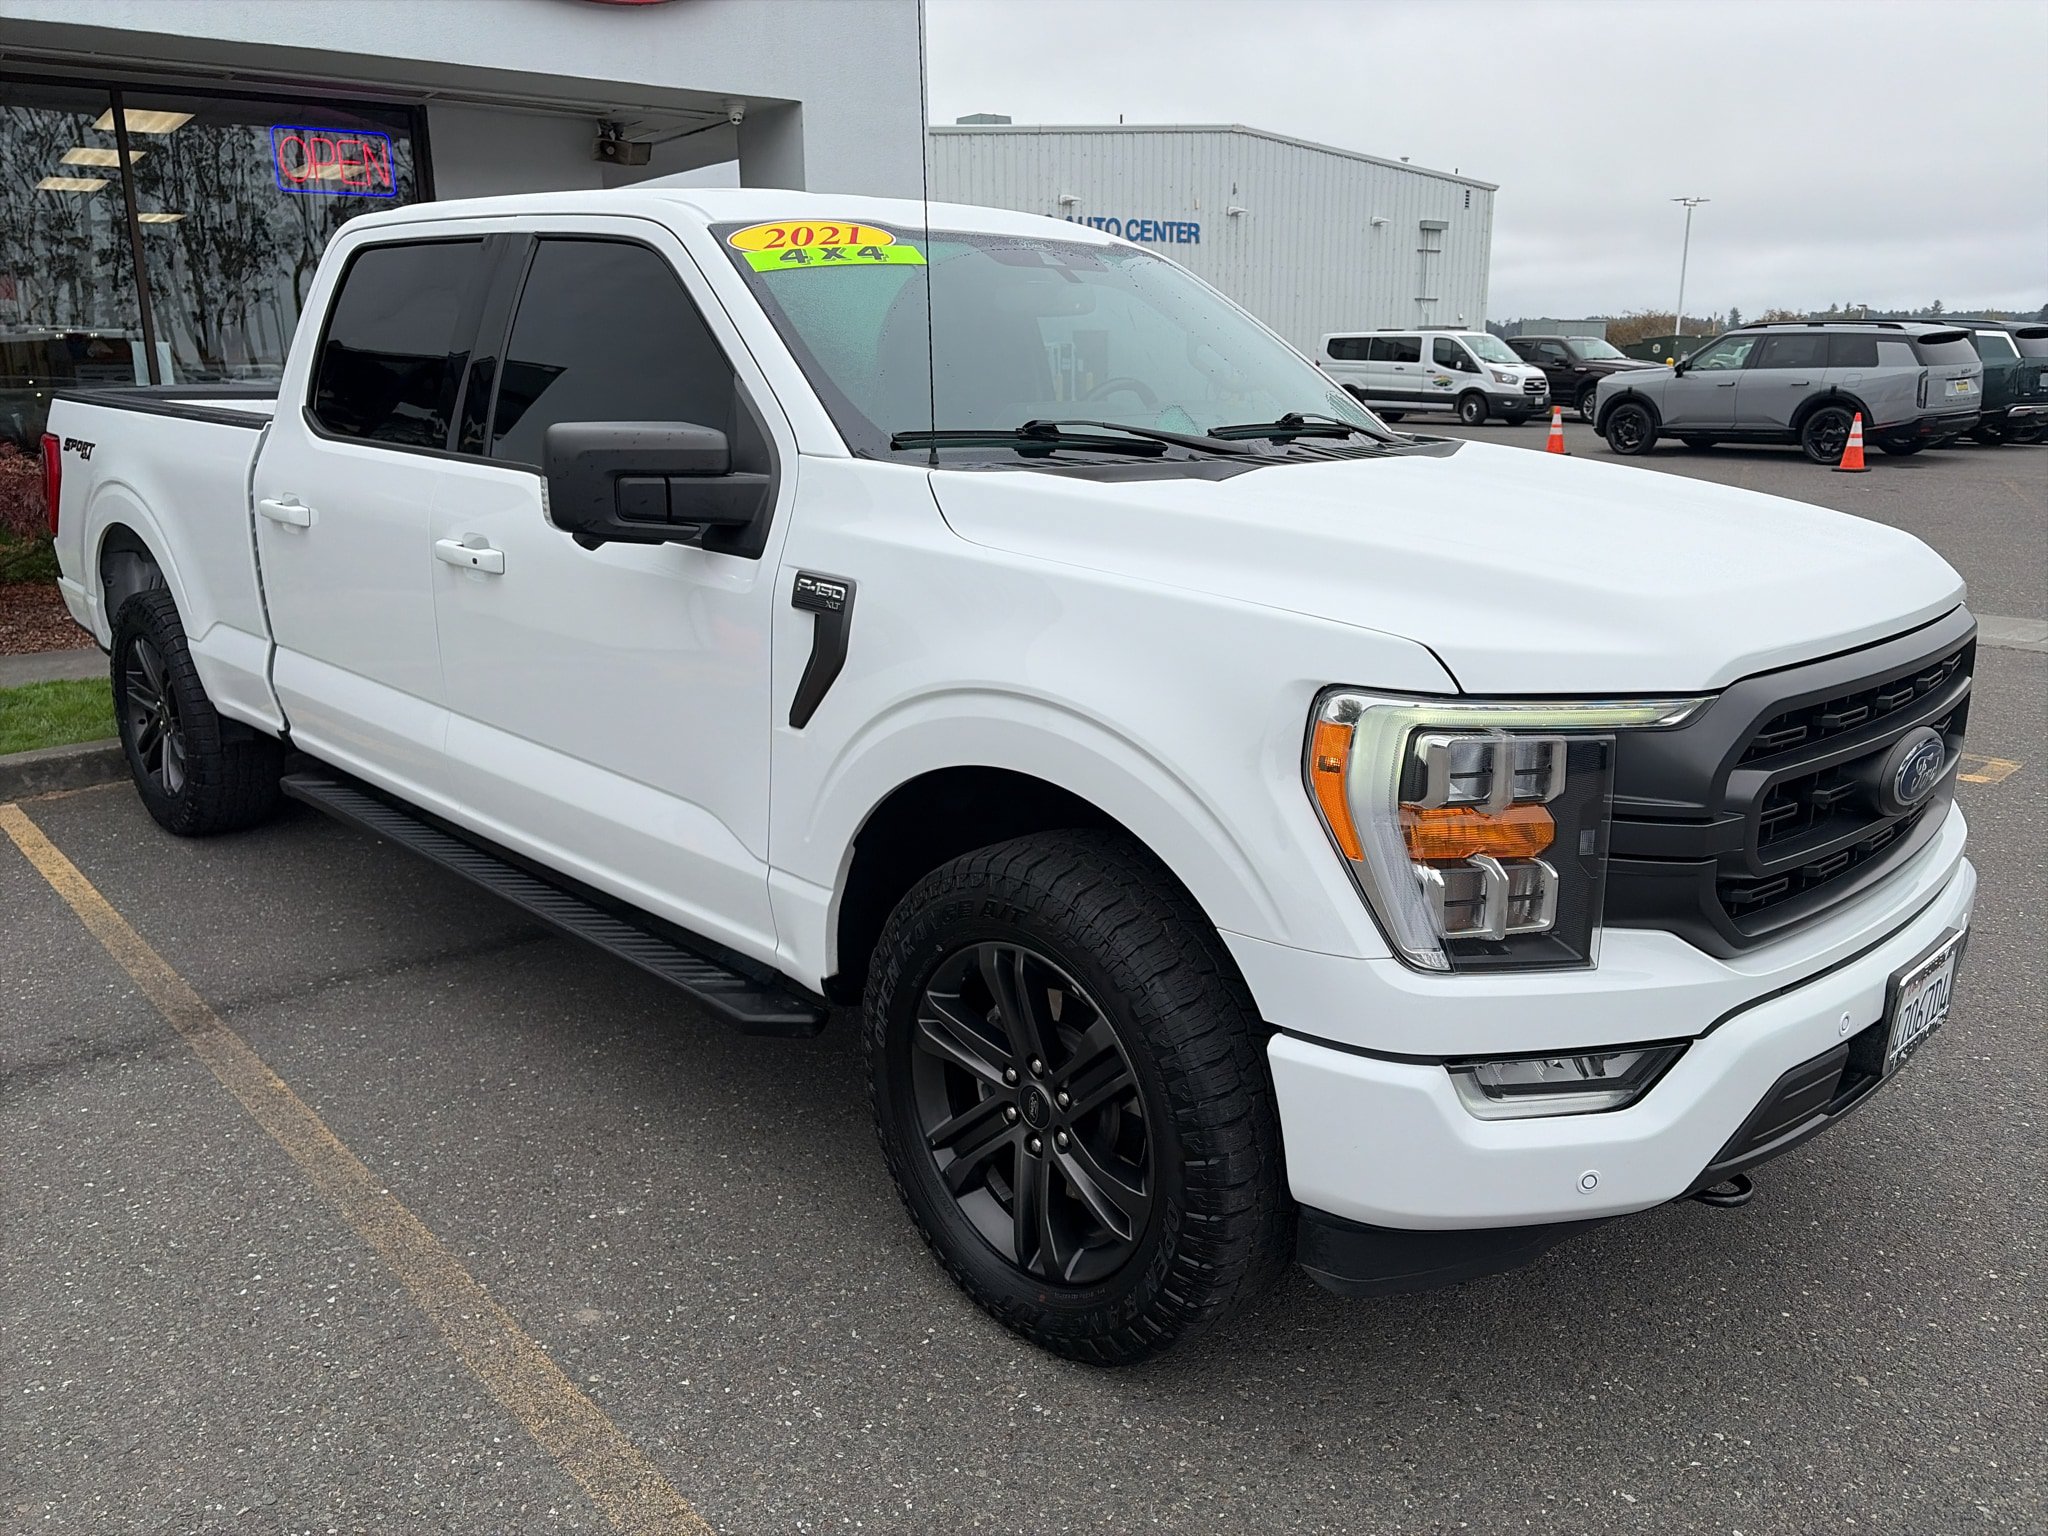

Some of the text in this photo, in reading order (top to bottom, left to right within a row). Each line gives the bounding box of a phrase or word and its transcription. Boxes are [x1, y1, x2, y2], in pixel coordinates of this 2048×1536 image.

[279, 136, 390, 186] OPEN
[763, 226, 862, 249] 2021
[1126, 219, 1200, 244] CENTER
[63, 437, 96, 453] SPORT
[797, 578, 846, 601] F-150
[825, 600, 841, 610] XLT
[874, 957, 903, 1046] OPEN
